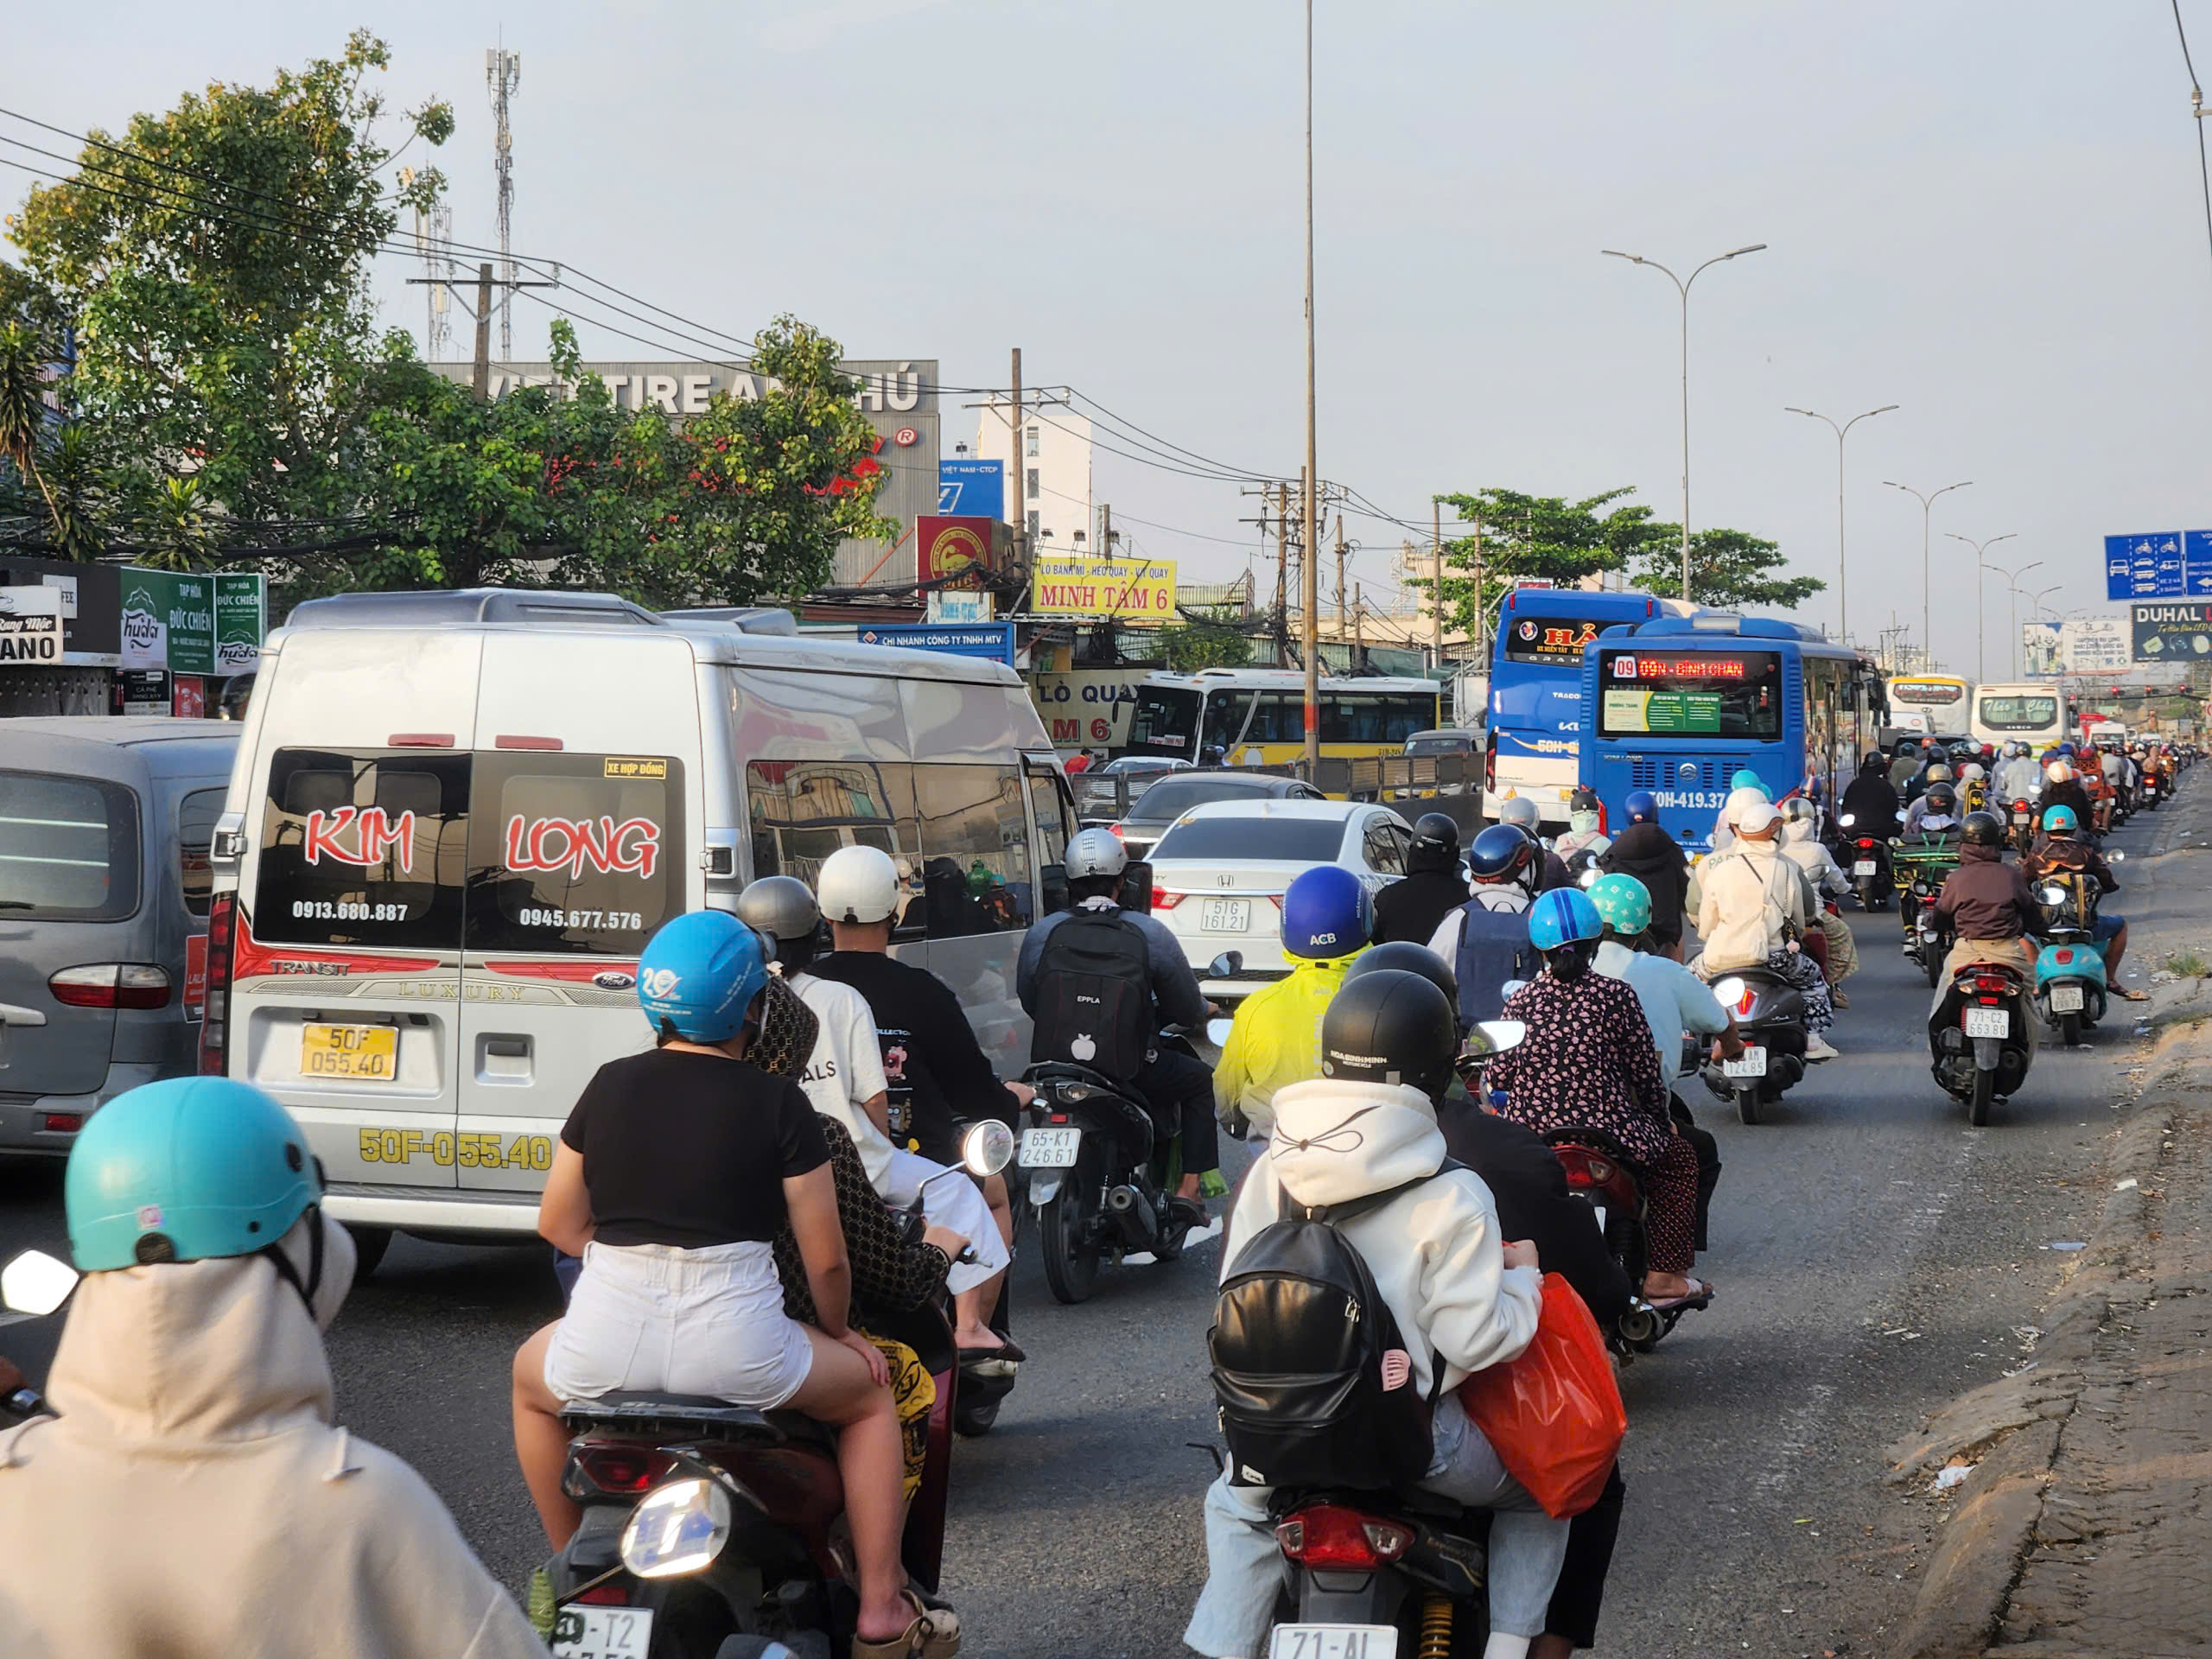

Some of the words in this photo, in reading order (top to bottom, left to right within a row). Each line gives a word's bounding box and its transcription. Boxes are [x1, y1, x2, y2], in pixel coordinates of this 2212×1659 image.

[467, 374, 711, 414] VTTIRE
[850, 362, 918, 412] HÚ
[1041, 562, 1051, 575] LÒ
[1053, 563, 1073, 575] BÁNH
[1076, 563, 1085, 575] MÌ
[1091, 566, 1107, 576] HEO
[1109, 566, 1128, 577] QUAY
[1149, 568, 1169, 579] QUAY
[217, 595, 233, 606] ĐỨC
[235, 593, 259, 606] CHIẾN
[1040, 585, 1096, 607] MINH
[1103, 581, 1149, 609] TÂM
[1156, 588, 1167, 610] 6
[169, 607, 187, 630] ĐỨC
[188, 607, 212, 632] CHIẾN
[2136, 607, 2202, 622] DUHAL
[25, 617, 53, 632] Mộc
[882, 636, 895, 646] CHI
[897, 634, 925, 645] NHÁNH
[926, 634, 950, 645] CÔNG
[951, 635, 961, 645] TY
[963, 635, 983, 645] TNHH
[984, 635, 1002, 645] MTV
[0, 637, 55, 660] ANO
[1618, 660, 1634, 675] 09
[1039, 681, 1071, 702] LÒ
[1090, 719, 1111, 741] 6
[607, 763, 620, 773] XE
[620, 762, 639, 776] HỢP
[305, 804, 416, 874] KIM
[505, 814, 661, 880] LONG
[292, 899, 408, 922] 0913.680.887
[1214, 900, 1238, 915] 51G
[520, 907, 643, 931] 0945.677.576
[1204, 914, 1244, 930] 161.21
[1310, 932, 1337, 946] ACB
[270, 960, 352, 976] TRANSIT
[600, 974, 627, 987] Ford
[399, 982, 526, 1001] LUXURY
[1077, 995, 1101, 1005] EPPLA
[329, 1028, 372, 1052] 50F
[311, 1052, 384, 1075] 055.40
[1033, 1132, 1071, 1147] 65-K1
[359, 1128, 552, 1171] 50F-055.40
[1023, 1148, 1074, 1164] 246.61
